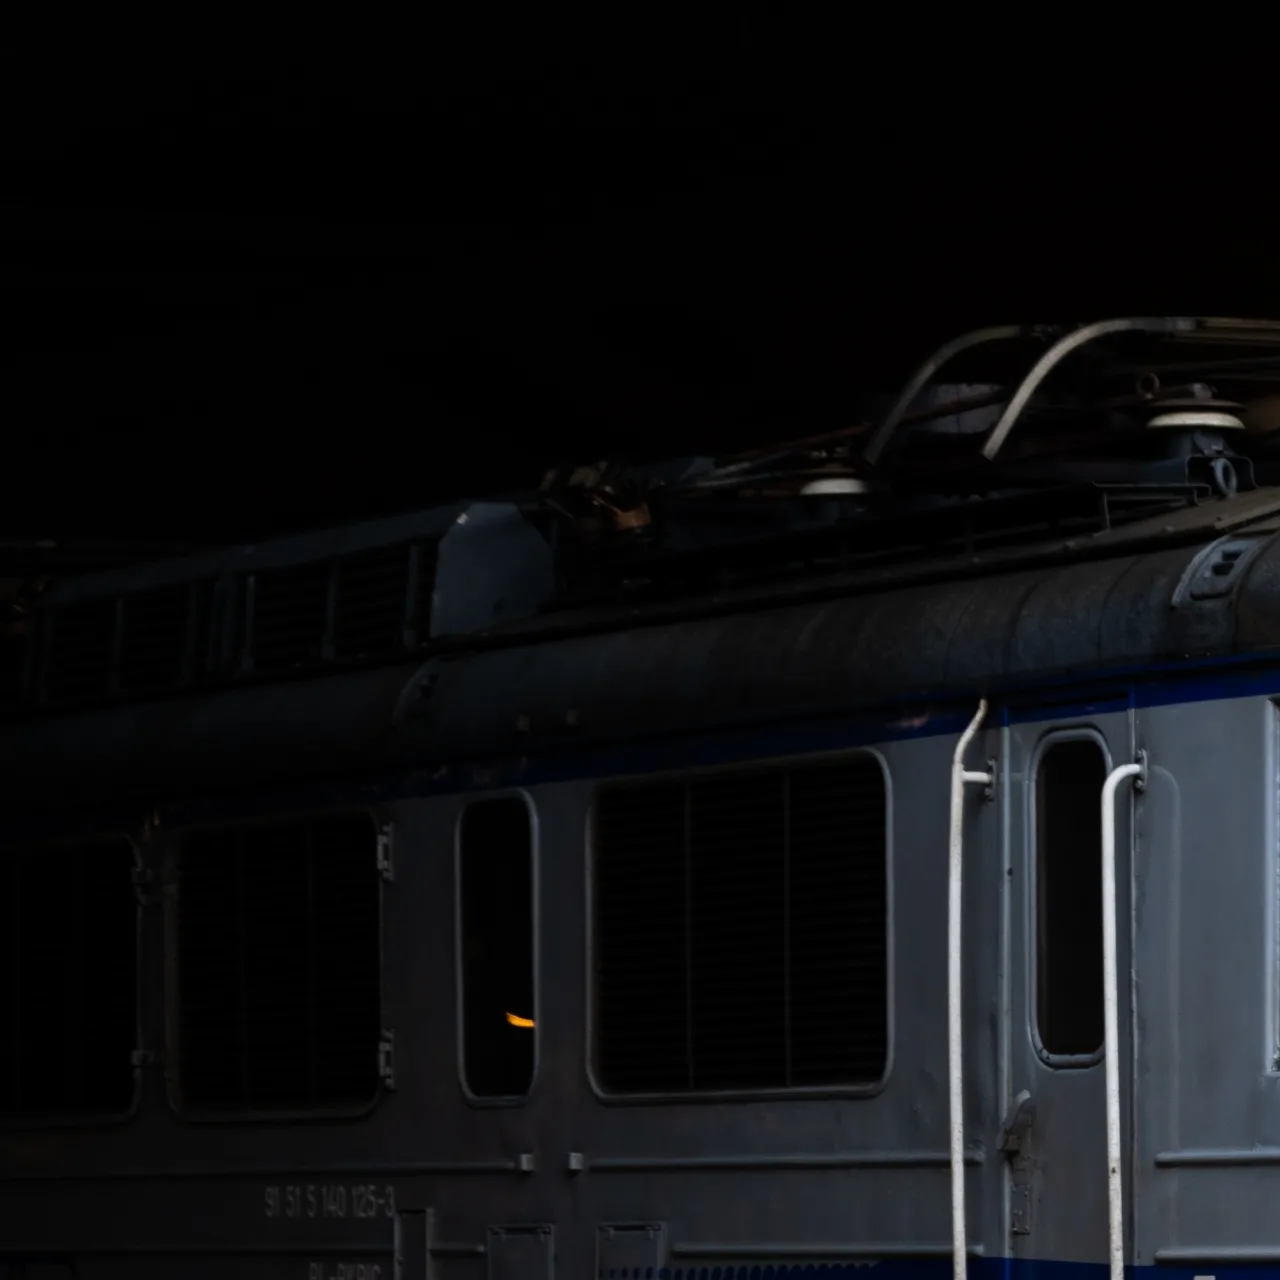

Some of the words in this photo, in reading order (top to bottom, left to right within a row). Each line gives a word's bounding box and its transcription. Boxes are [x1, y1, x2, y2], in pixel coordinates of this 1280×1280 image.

[264, 1185, 281, 1218] 91
[285, 1185, 301, 1218] 51
[306, 1184, 317, 1218] 5
[320, 1184, 347, 1218] 140
[351, 1184, 396, 1218] 125-3
